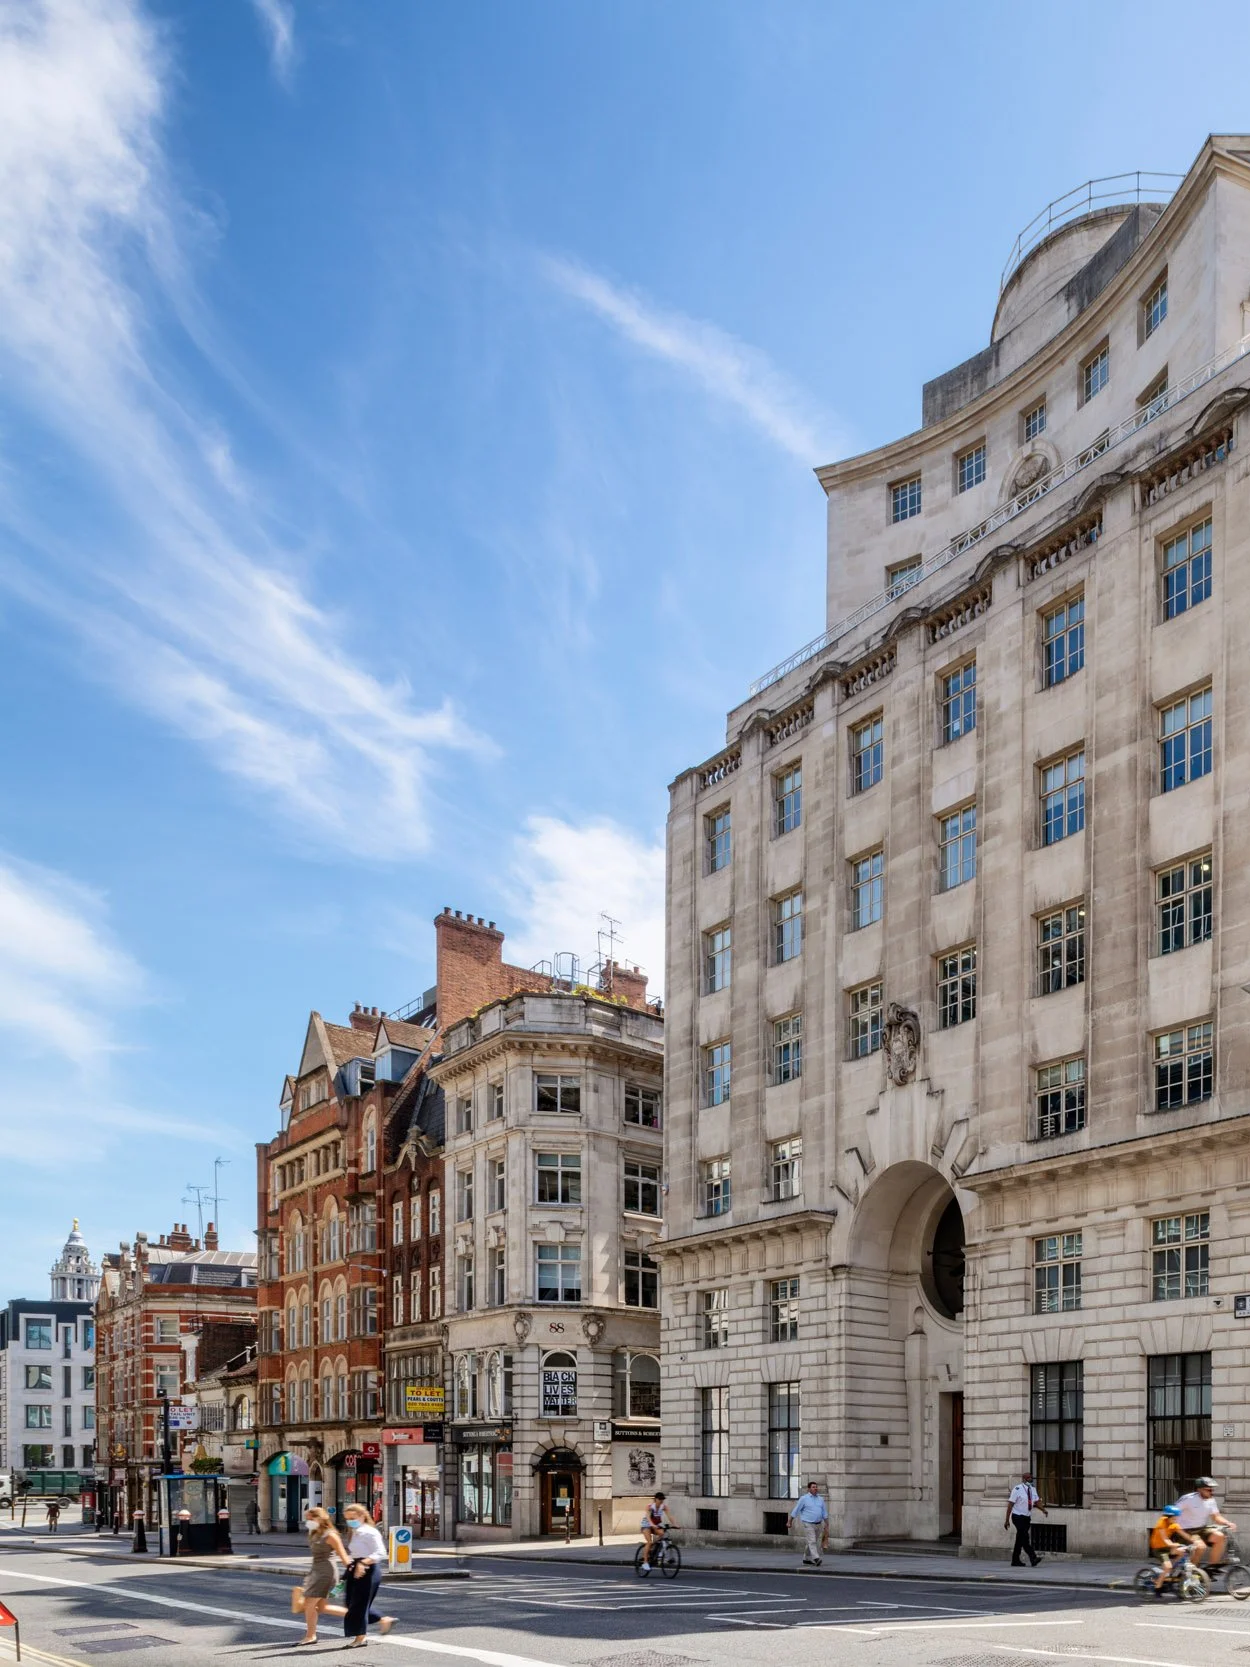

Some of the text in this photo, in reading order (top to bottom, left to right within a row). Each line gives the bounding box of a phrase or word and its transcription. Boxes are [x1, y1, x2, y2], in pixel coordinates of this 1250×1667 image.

[549, 1322, 565, 1333] 88
[543, 1372, 574, 1381] BLACK
[544, 1385, 573, 1394] LIVES
[544, 1397, 576, 1405] MATTER
